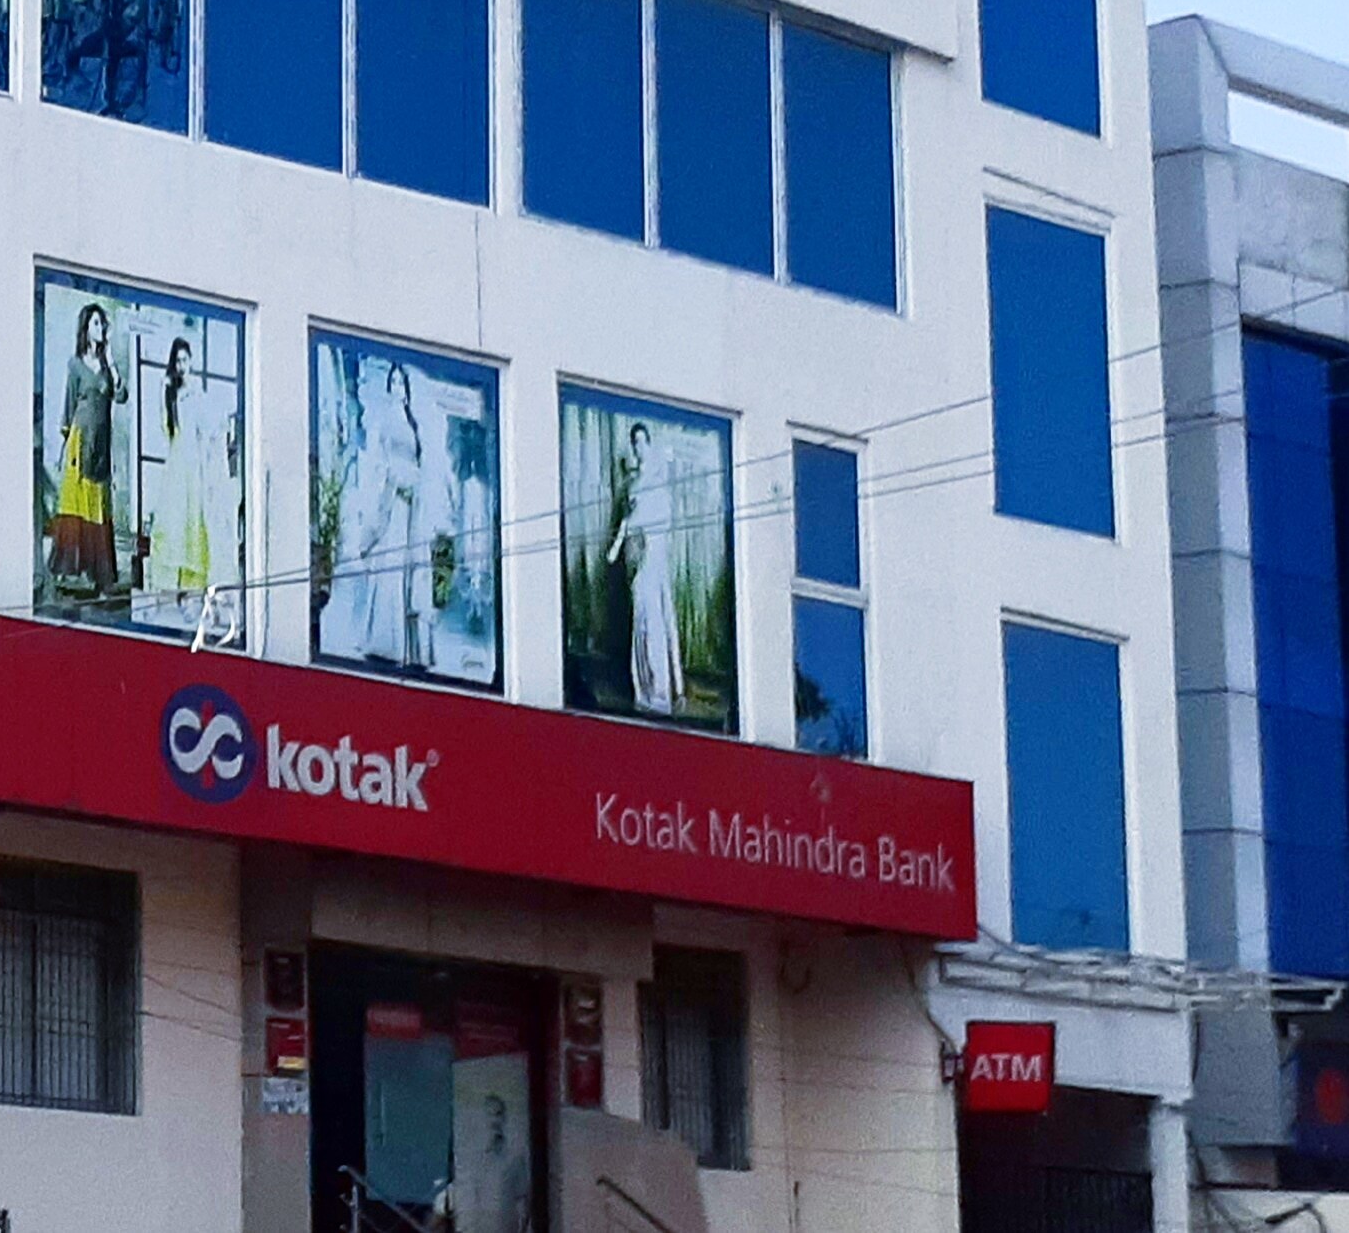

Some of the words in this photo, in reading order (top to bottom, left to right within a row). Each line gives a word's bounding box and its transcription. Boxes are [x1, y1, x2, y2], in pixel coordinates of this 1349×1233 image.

[266, 722, 429, 813] kotak
[595, 792, 697, 854] Kotak
[708, 808, 867, 880] Mahindra
[877, 835, 956, 893] Bank
[970, 1052, 1043, 1082] ATM
